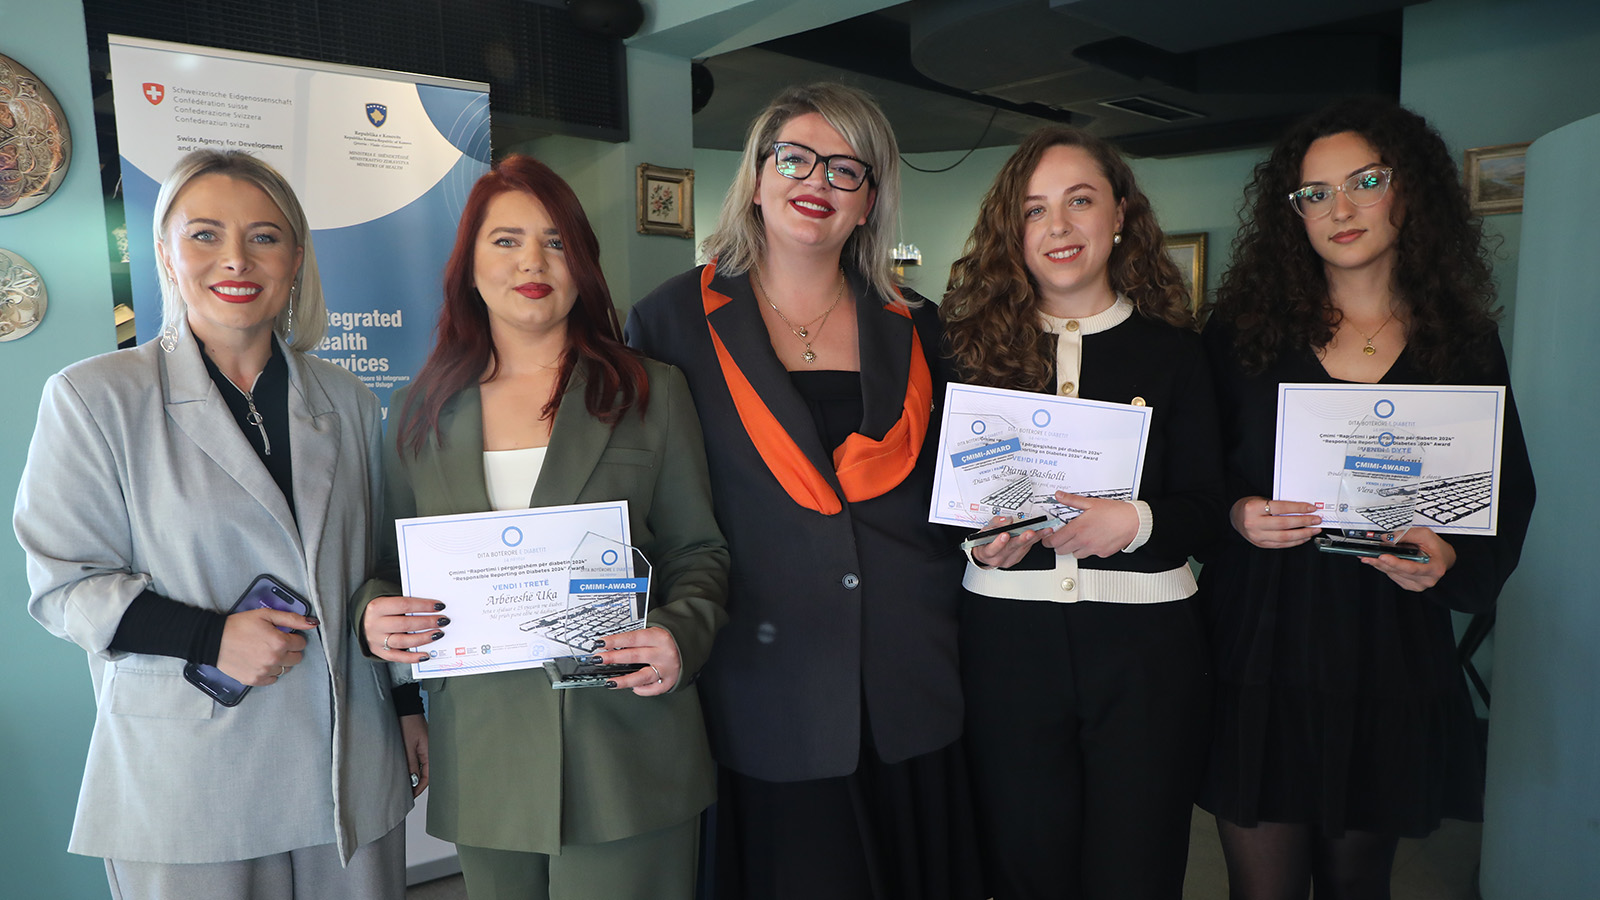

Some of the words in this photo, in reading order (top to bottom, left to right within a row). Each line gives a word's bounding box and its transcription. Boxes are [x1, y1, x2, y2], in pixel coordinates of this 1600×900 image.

[172, 87, 227, 98] Schweizerische
[229, 92, 292, 106] Eidgenossenschaft
[173, 96, 226, 108] Confédération
[174, 106, 231, 117] Confederazione
[233, 112, 262, 120] Svizzera
[175, 116, 228, 126] Confederaziun
[198, 137, 224, 146] Agency
[238, 140, 284, 150] Development
[326, 308, 402, 330] egrated
[316, 333, 368, 351] ealth
[312, 354, 390, 372] rvices
[961, 445, 1011, 463] ÇMIMI-AWARD
[1355, 461, 1410, 472] ÇMIMI-AWARD
[1030, 468, 1066, 481] Basholli
[492, 582, 517, 591] VENDI
[580, 583, 637, 592] ÇMIMI-AWARD
[486, 590, 534, 606] Arbëreshë
[536, 588, 558, 602] Uka
